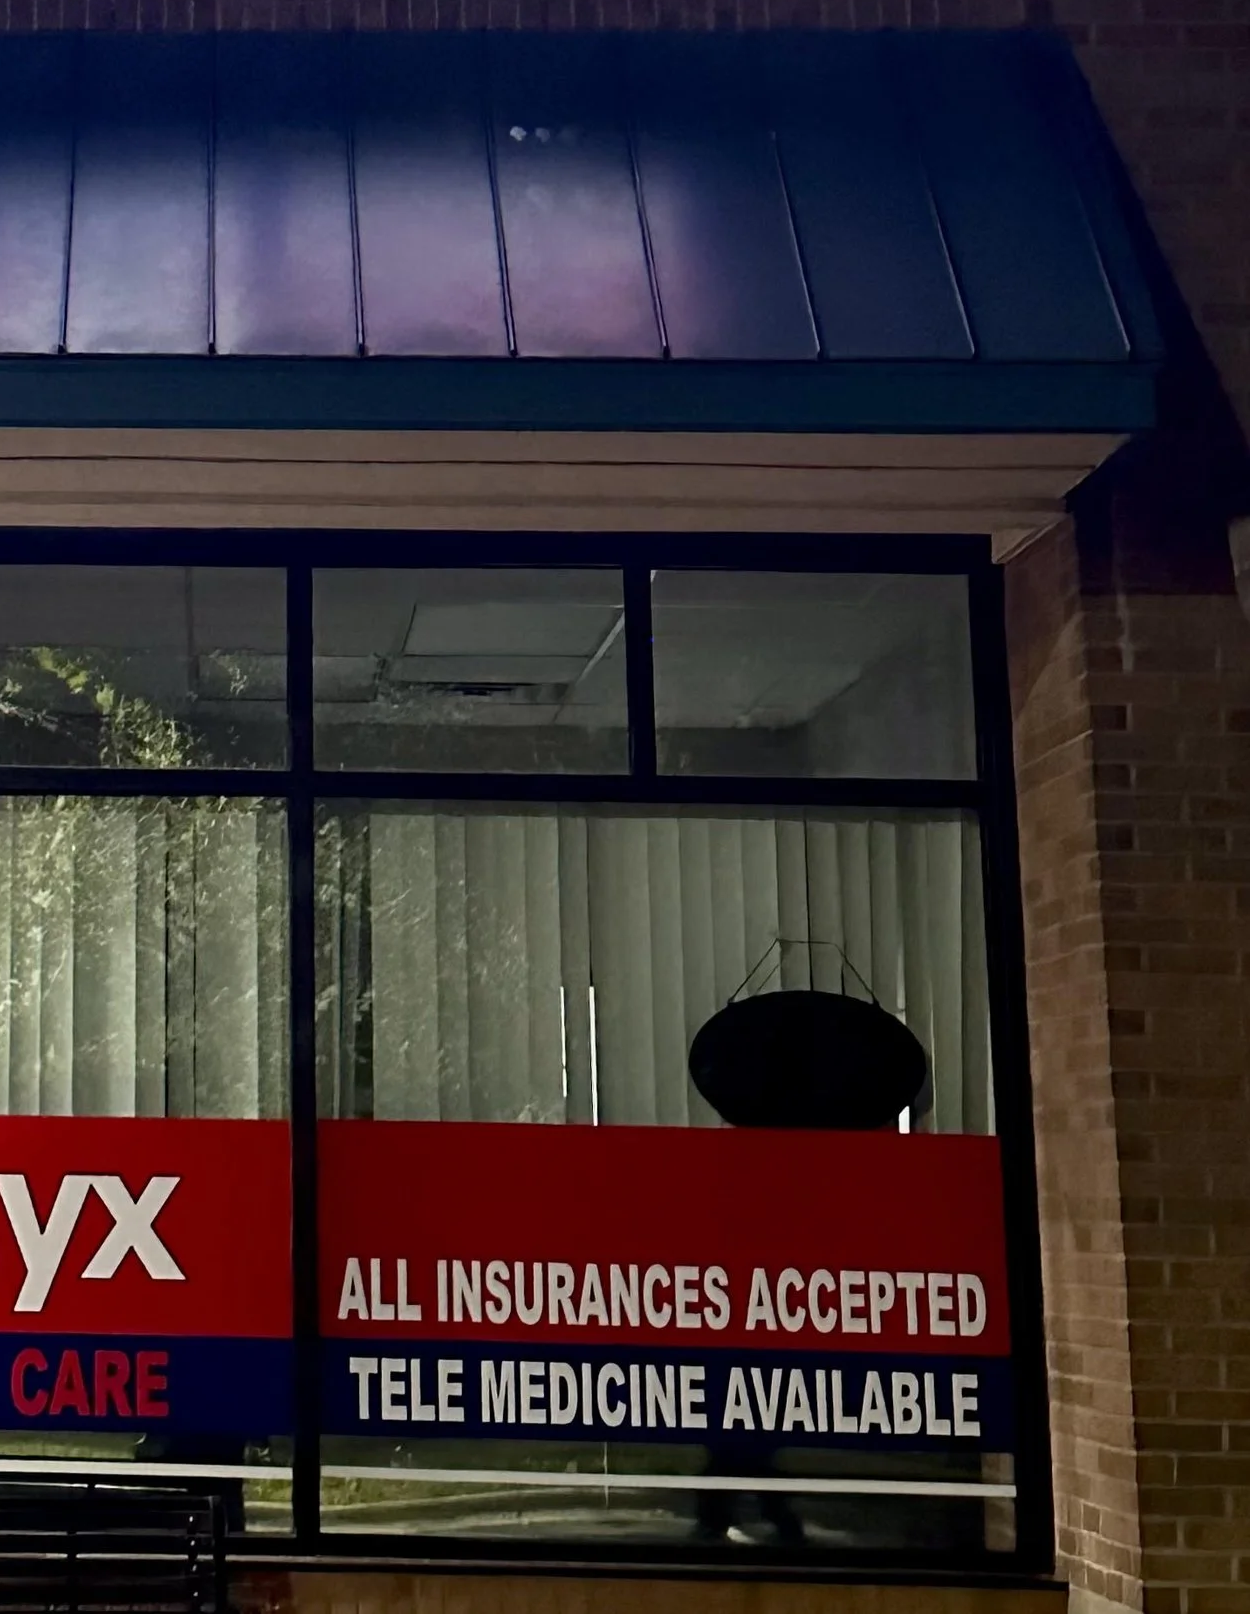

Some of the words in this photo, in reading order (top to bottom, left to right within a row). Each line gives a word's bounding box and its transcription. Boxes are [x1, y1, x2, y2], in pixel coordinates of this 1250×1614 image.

[337, 1257, 423, 1322] ALL
[436, 1259, 731, 1330] INSURANCES
[744, 1267, 987, 1337] ACCEPTED
[10, 1349, 170, 1417] CARE
[349, 1357, 465, 1422] TELE
[480, 1360, 708, 1429] MEDICINE
[722, 1367, 981, 1437] AVAILABLE
